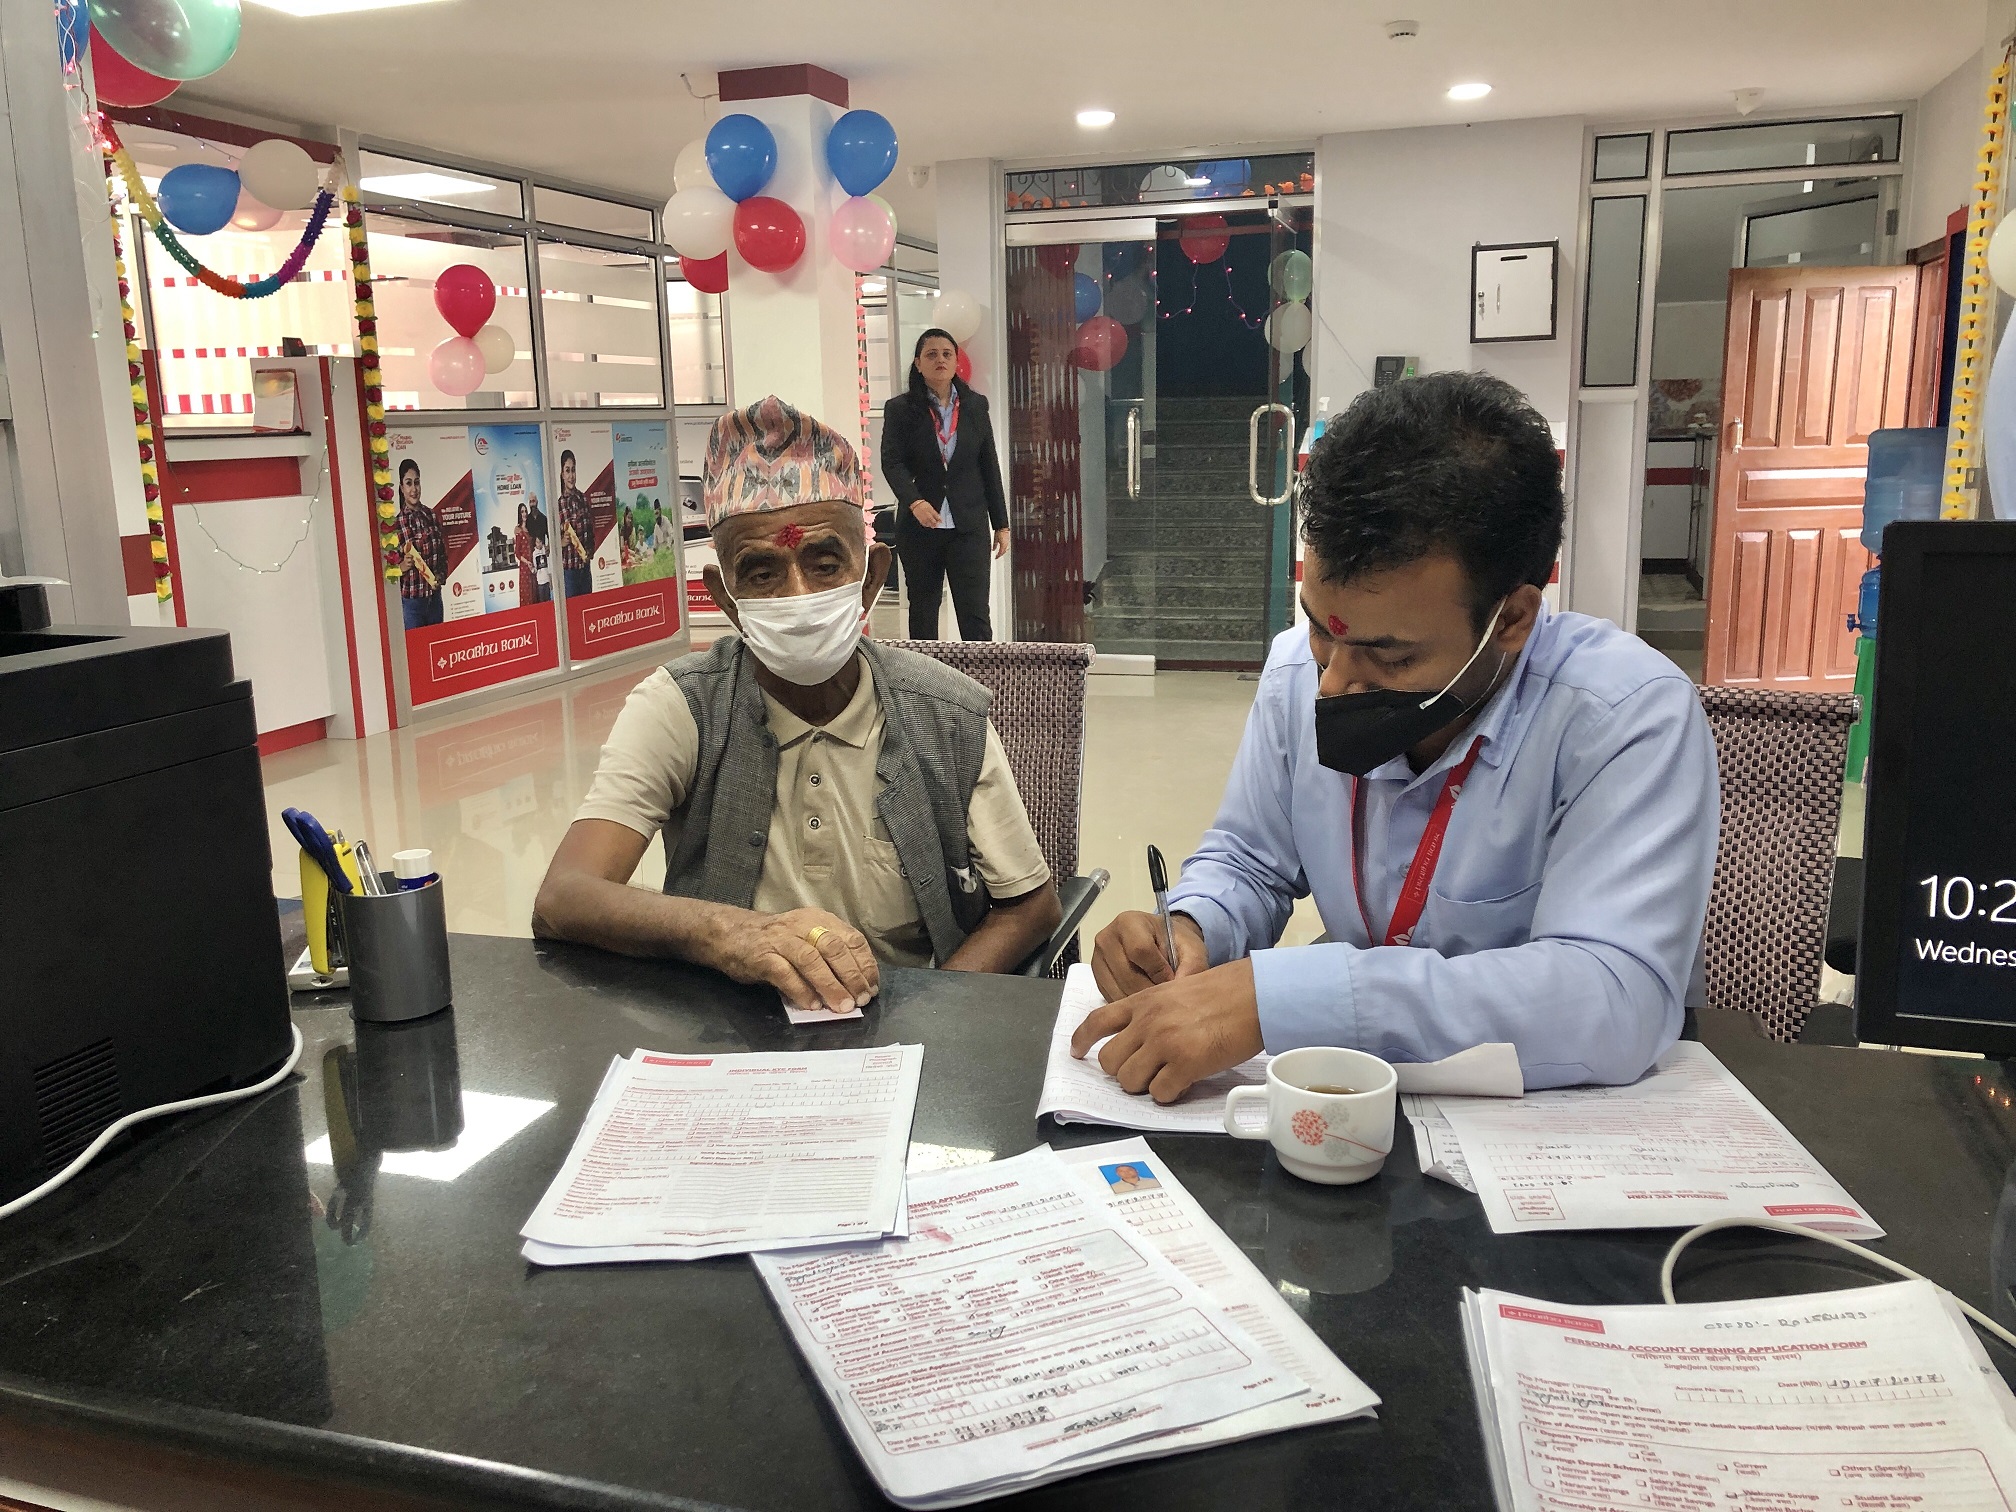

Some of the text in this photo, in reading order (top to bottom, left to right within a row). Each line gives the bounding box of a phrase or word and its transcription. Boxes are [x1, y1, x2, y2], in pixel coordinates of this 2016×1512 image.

[1920, 875, 2016, 923] 10:2
[1916, 938, 2016, 967] Wednes
[938, 1187, 993, 1204] APPLICATION
[994, 1180, 1019, 1190] FORM
[1564, 1336, 1868, 1355] PERSONAL ACCOUNT OPENING APPLICATION FORM
[1305, 1401, 1322, 1409] Page
[1565, 1422, 1598, 1432] Account
[1710, 1422, 1736, 1430] details
[1738, 1423, 1774, 1432] specified
[1545, 1454, 1576, 1464] Savings
[1613, 1463, 1647, 1473] Scheme
[1733, 1462, 1768, 1470] Current
[1591, 1470, 1622, 1479] Savings
[1599, 1487, 1630, 1496] Savings
[1676, 1482, 1707, 1491] Savings
